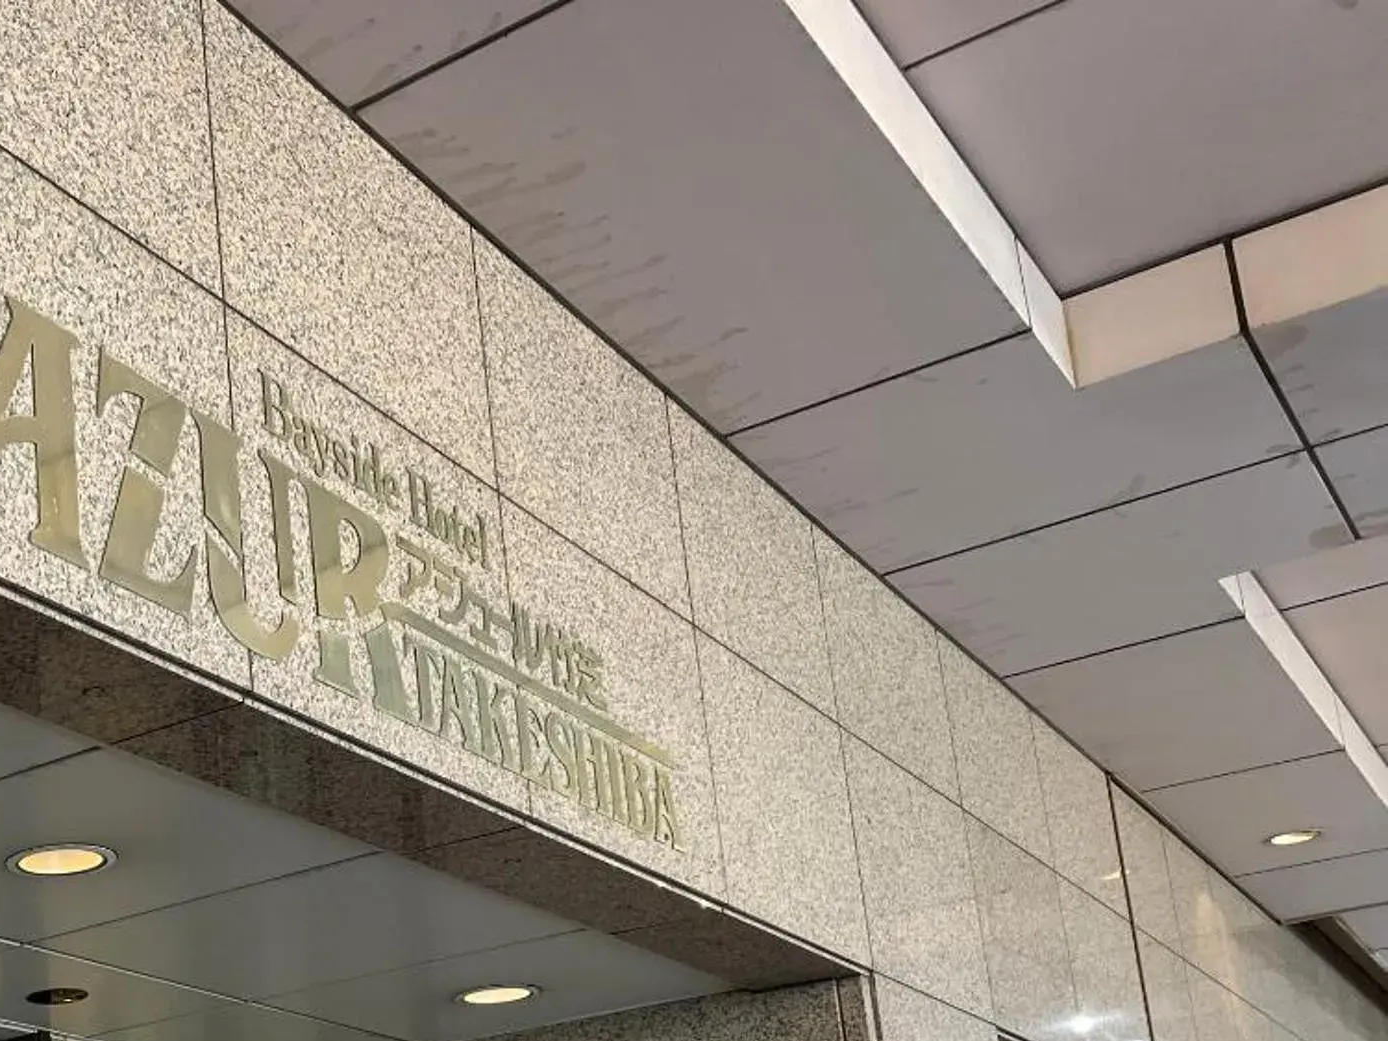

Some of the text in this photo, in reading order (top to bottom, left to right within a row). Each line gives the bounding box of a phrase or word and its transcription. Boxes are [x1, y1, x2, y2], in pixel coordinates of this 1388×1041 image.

[257, 367, 491, 572] Bayside Hotel
[395, 533, 610, 712] アジュール竹芝
[399, 625, 688, 853] TAKESHIBA
